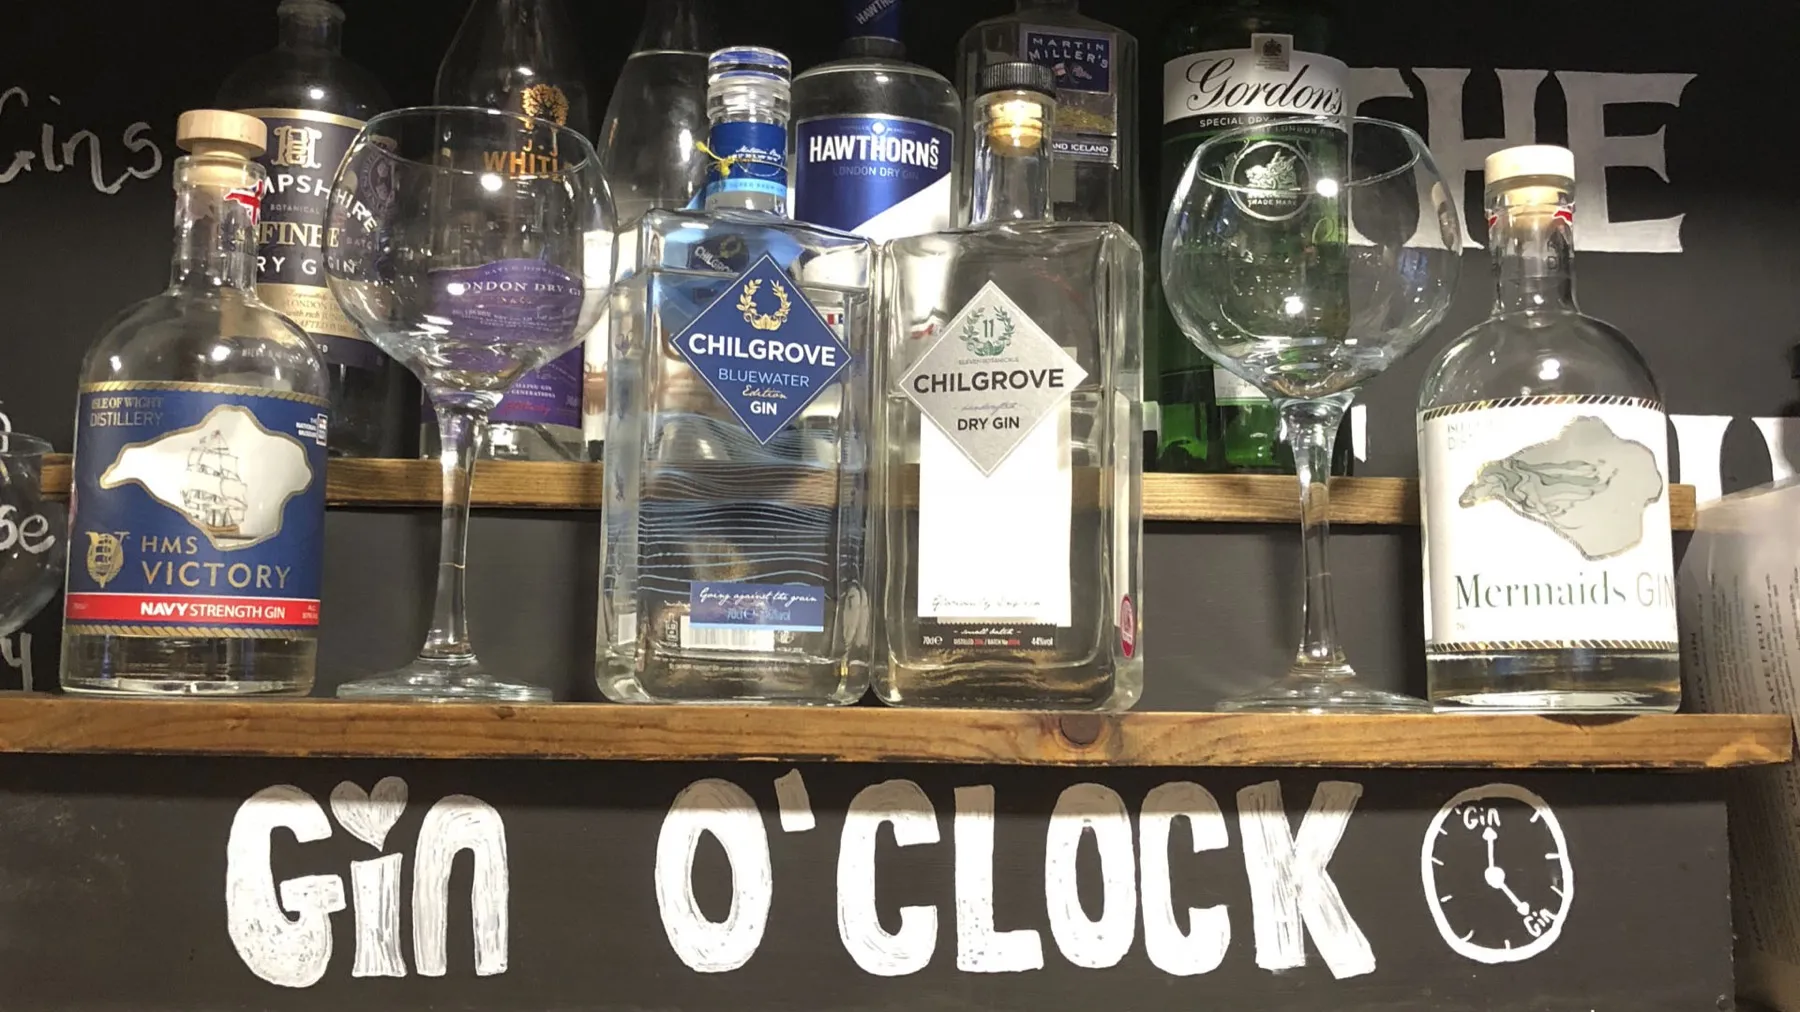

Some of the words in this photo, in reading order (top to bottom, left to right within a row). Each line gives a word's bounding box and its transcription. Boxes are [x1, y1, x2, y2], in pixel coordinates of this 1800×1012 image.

[1033, 37, 1104, 52] MARTIN
[1029, 49, 1109, 69] MILLER'S
[1185, 57, 1344, 115] Gordon's
[1200, 116, 1244, 128] SPECIAL
[1071, 143, 1109, 154] ICELAND
[483, 151, 573, 182] WHITL
[833, 166, 877, 177] LONDON
[880, 167, 900, 178] DRY
[902, 169, 920, 180] GIN
[257, 255, 286, 273] RY
[457, 281, 528, 293] ONDON
[534, 282, 565, 293] DRY
[688, 332, 837, 367] CHILGROVE
[718, 367, 810, 388] BLUEWATER
[913, 368, 1065, 394] CHILGROVE
[742, 384, 788, 400] Edition
[750, 400, 778, 416] GIN
[90, 410, 164, 428] DISTILLERY
[957, 417, 989, 431] DRY
[992, 415, 1020, 430] GIN
[141, 535, 199, 555] HMS
[141, 561, 291, 589] VICTORY
[699, 587, 731, 606] Going
[733, 590, 773, 605] against
[784, 594, 818, 607] grain
[1454, 570, 1627, 610] Mermaids
[1636, 571, 1675, 610] GIN
[140, 601, 190, 617] NAVY
[189, 604, 262, 619] STRENGTH
[264, 606, 287, 620] GIN
[1463, 806, 1501, 830] Gin
[224, 775, 509, 988] Gin
[654, 768, 1377, 980] O'CLOCK
[1523, 908, 1558, 938] Gin
